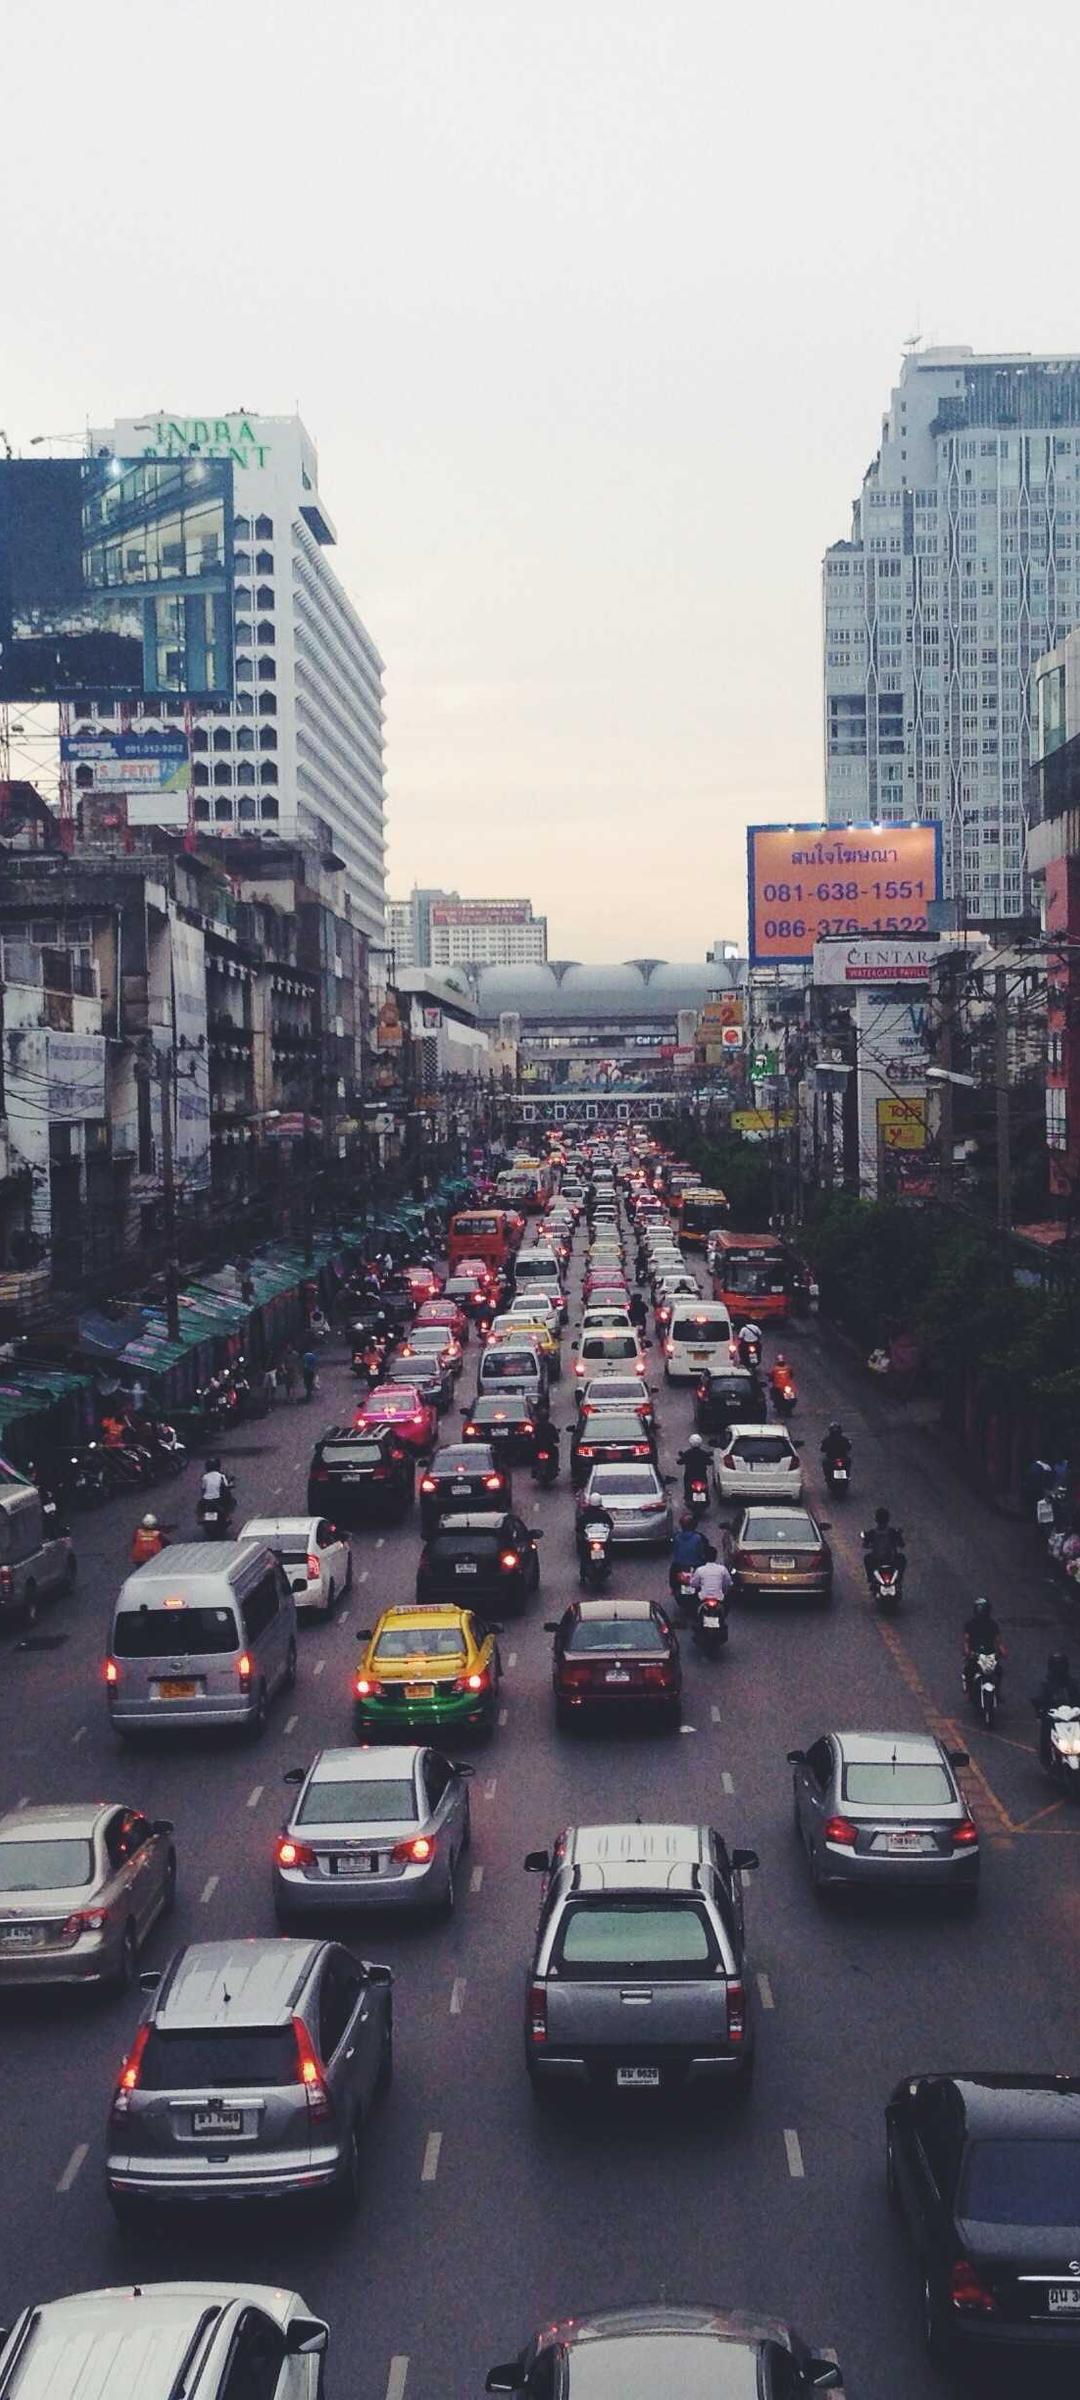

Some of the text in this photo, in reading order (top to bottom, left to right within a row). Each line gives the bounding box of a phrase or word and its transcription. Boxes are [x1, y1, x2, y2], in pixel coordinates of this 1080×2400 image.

[155, 421, 256, 443] INDRA
[791, 842, 898, 865] สนใจโฆษณา
[763, 880, 926, 902] 081-638-1551
[764, 916, 928, 938] 086-376-1522
[850, 966, 897, 979] WATERGATE
